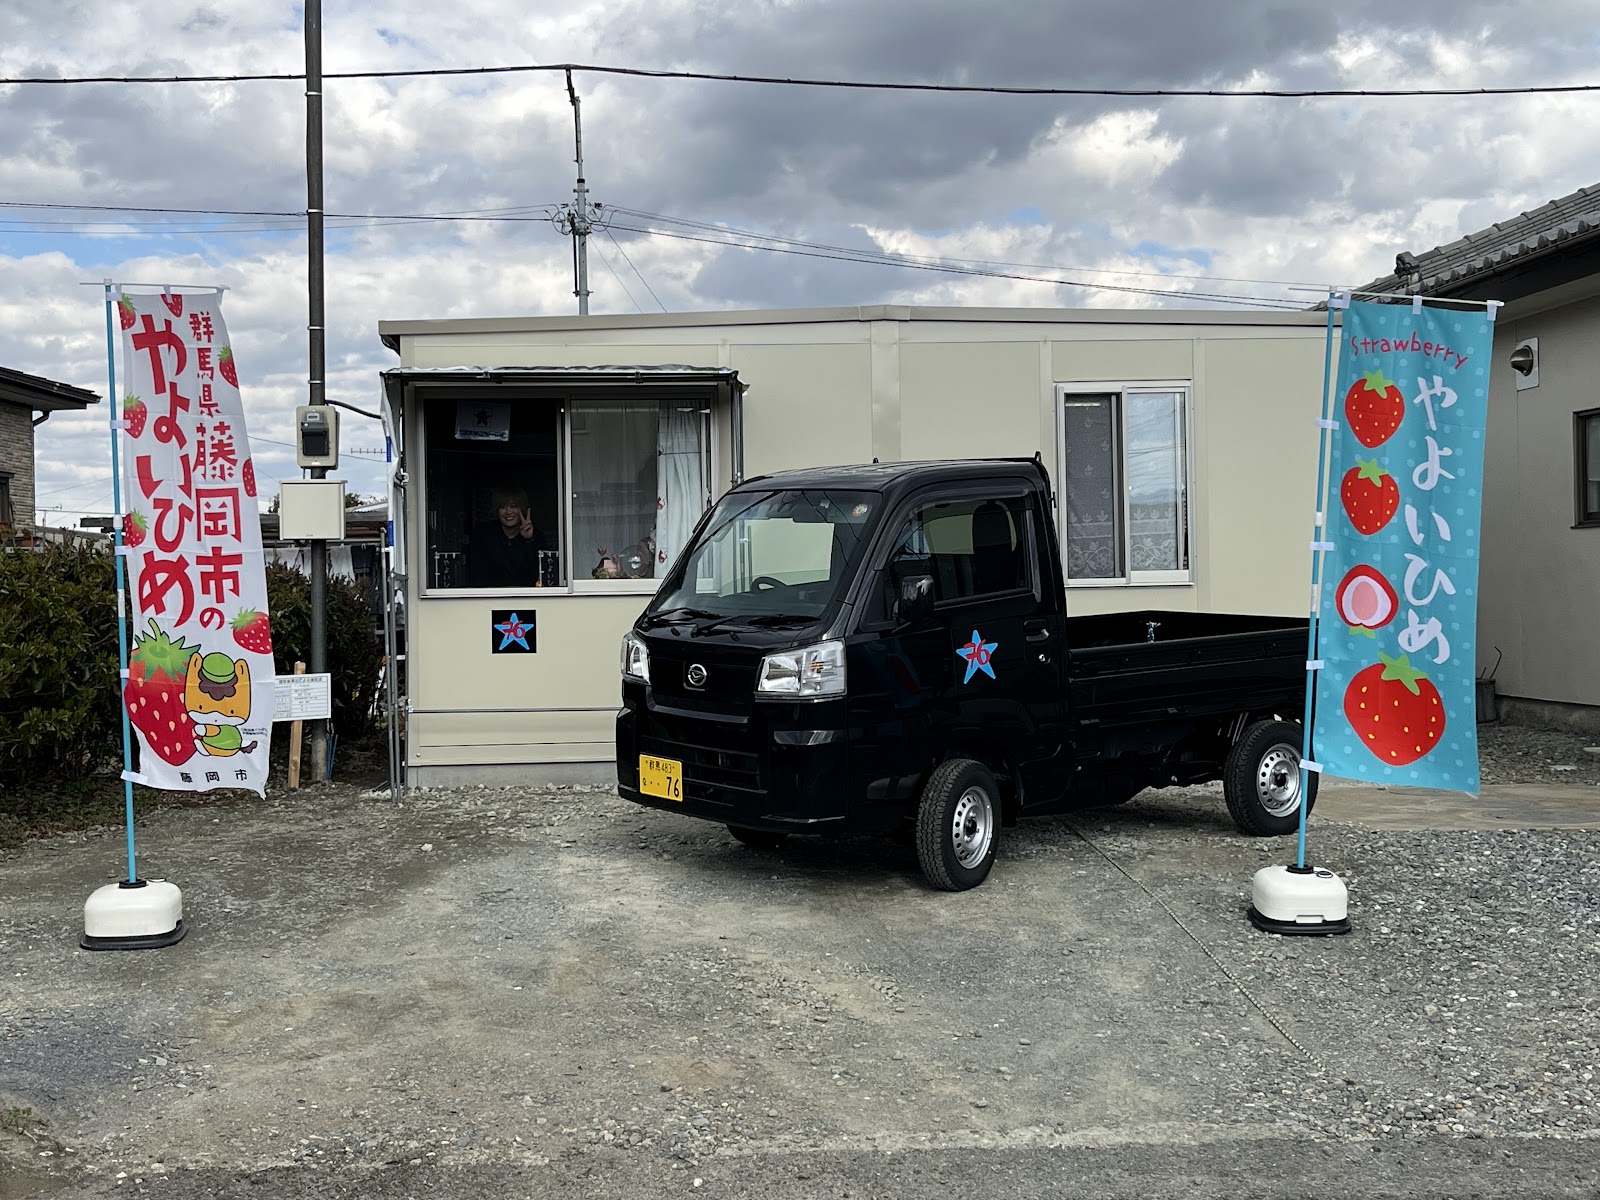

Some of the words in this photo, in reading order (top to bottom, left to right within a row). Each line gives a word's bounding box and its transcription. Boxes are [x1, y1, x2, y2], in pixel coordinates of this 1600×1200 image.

[131, 314, 194, 627] やよいひめ
[1397, 374, 1459, 664] やよいひめ
